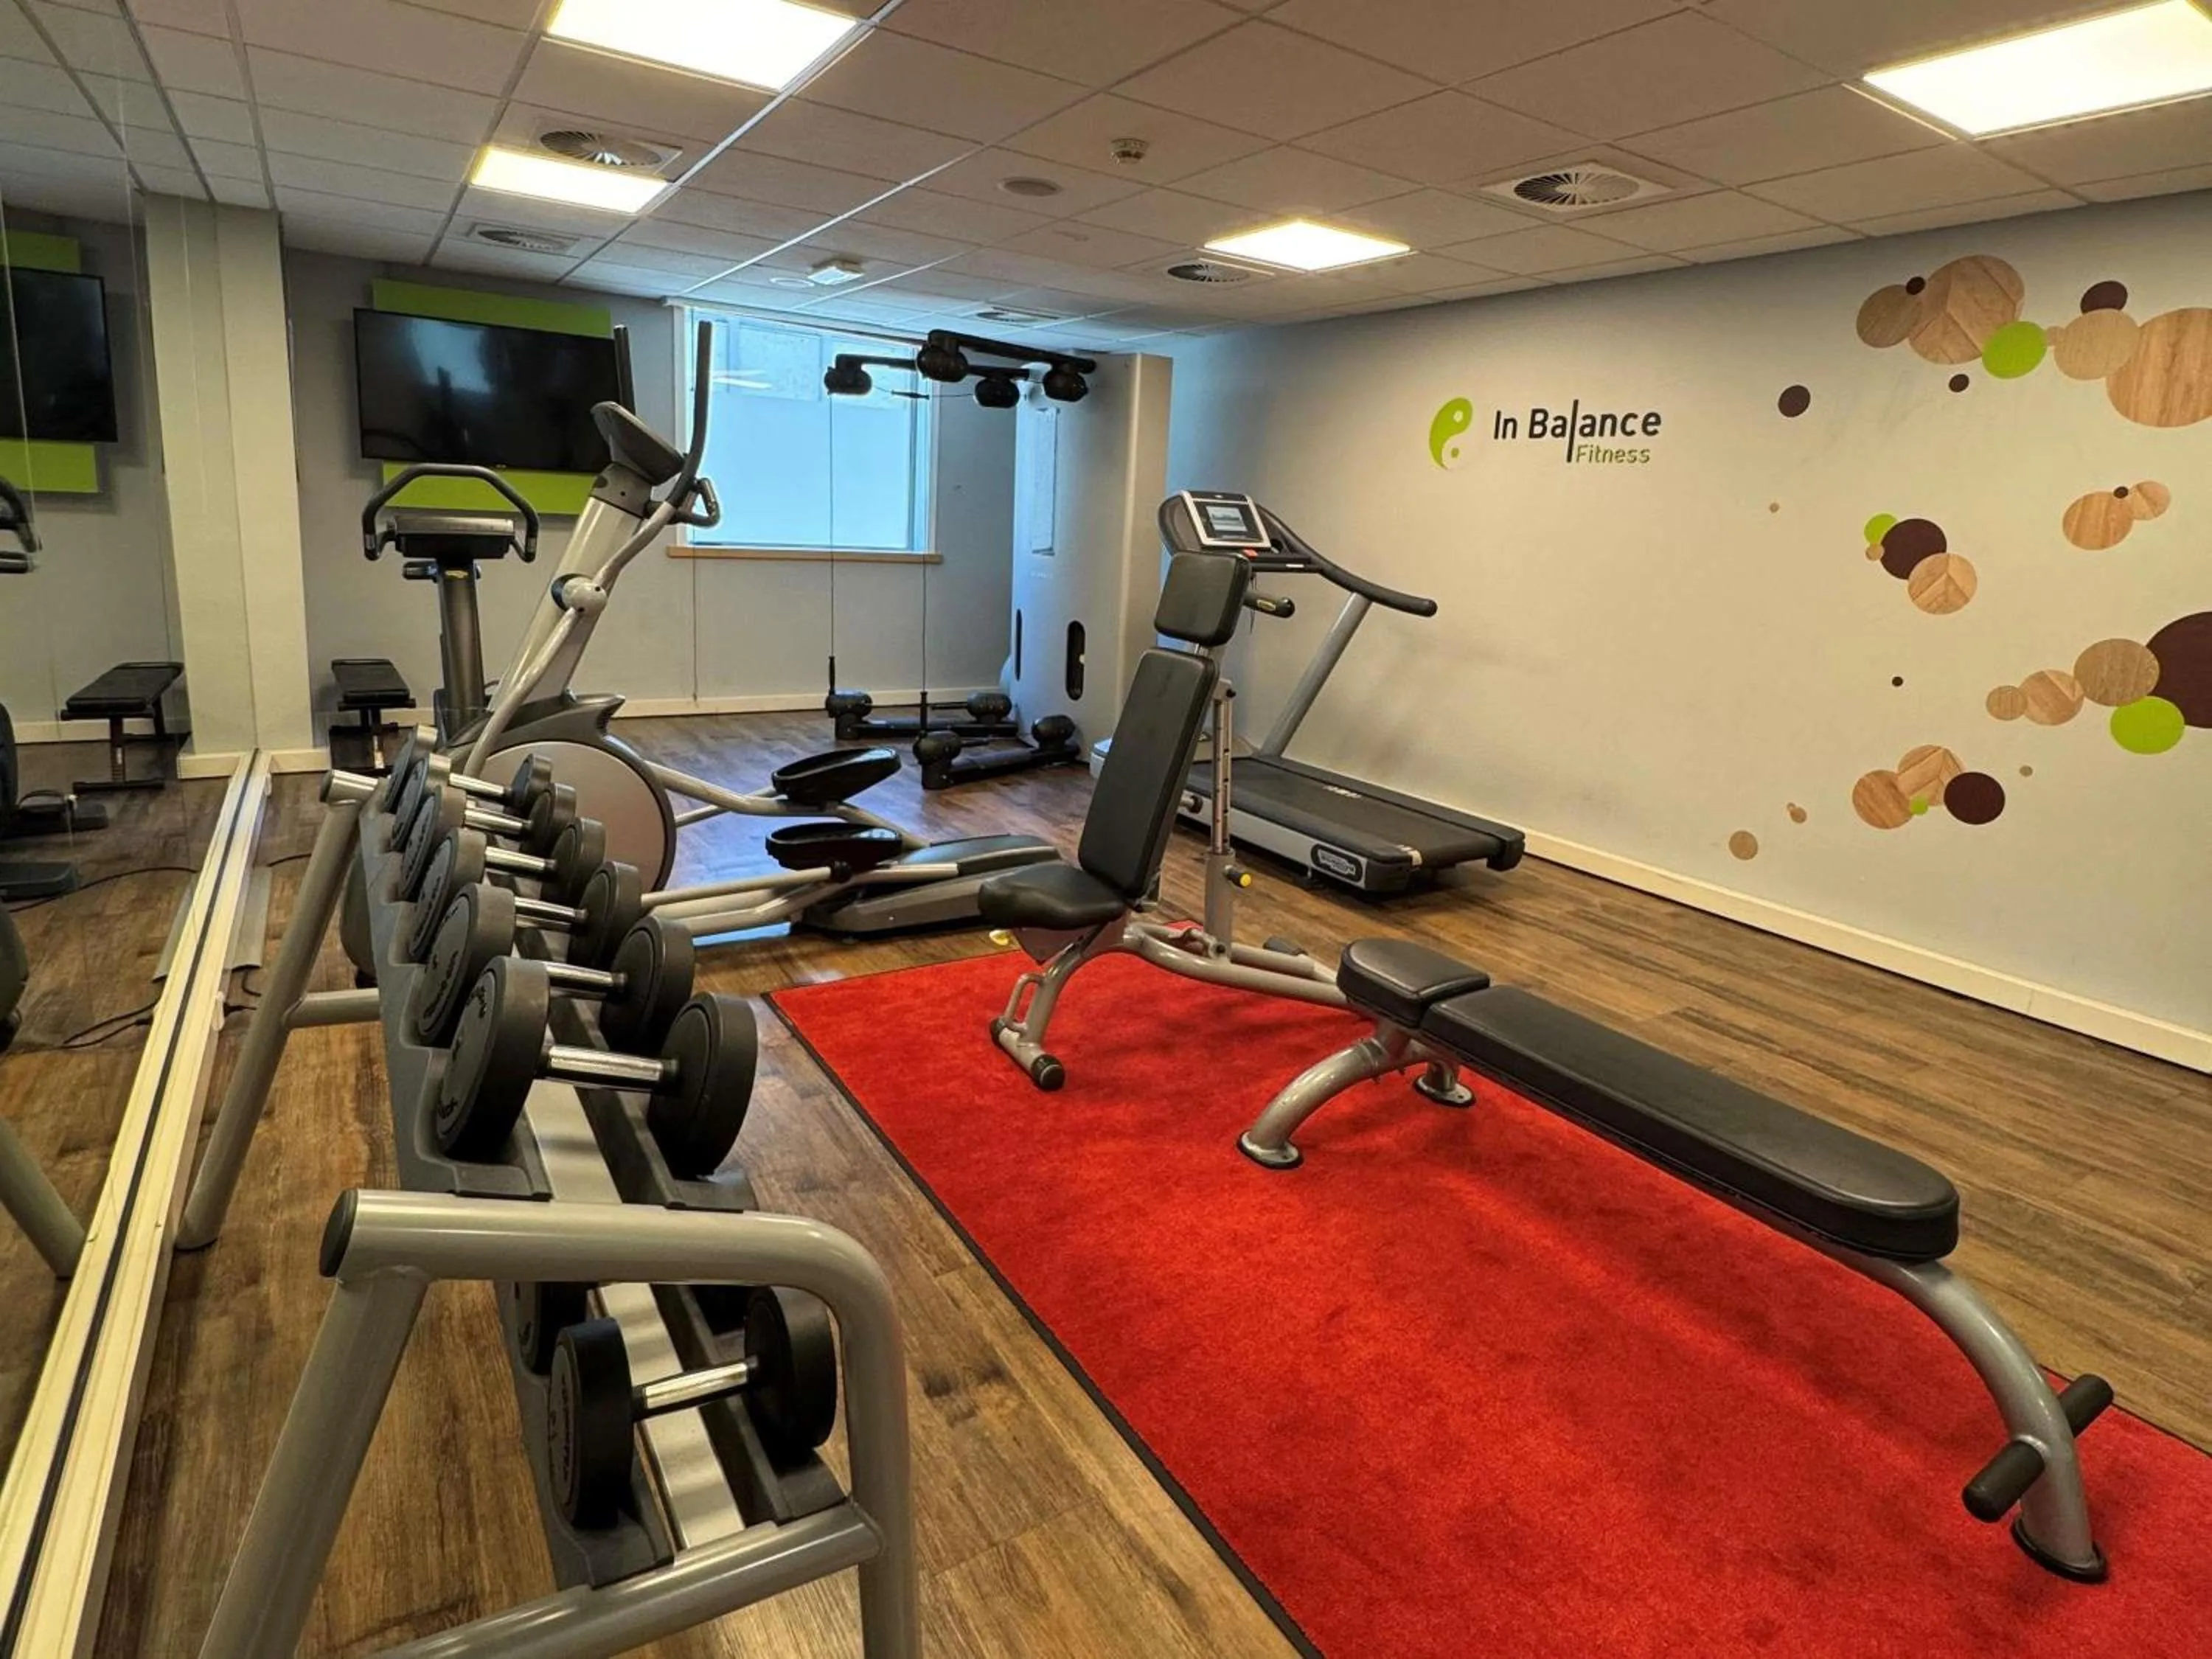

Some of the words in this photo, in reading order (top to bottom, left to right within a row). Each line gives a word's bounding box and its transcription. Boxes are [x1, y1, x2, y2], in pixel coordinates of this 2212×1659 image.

[1493, 410, 1517, 439] In
[1528, 399, 1662, 463] Balance
[1576, 444, 1651, 464] Fitness
